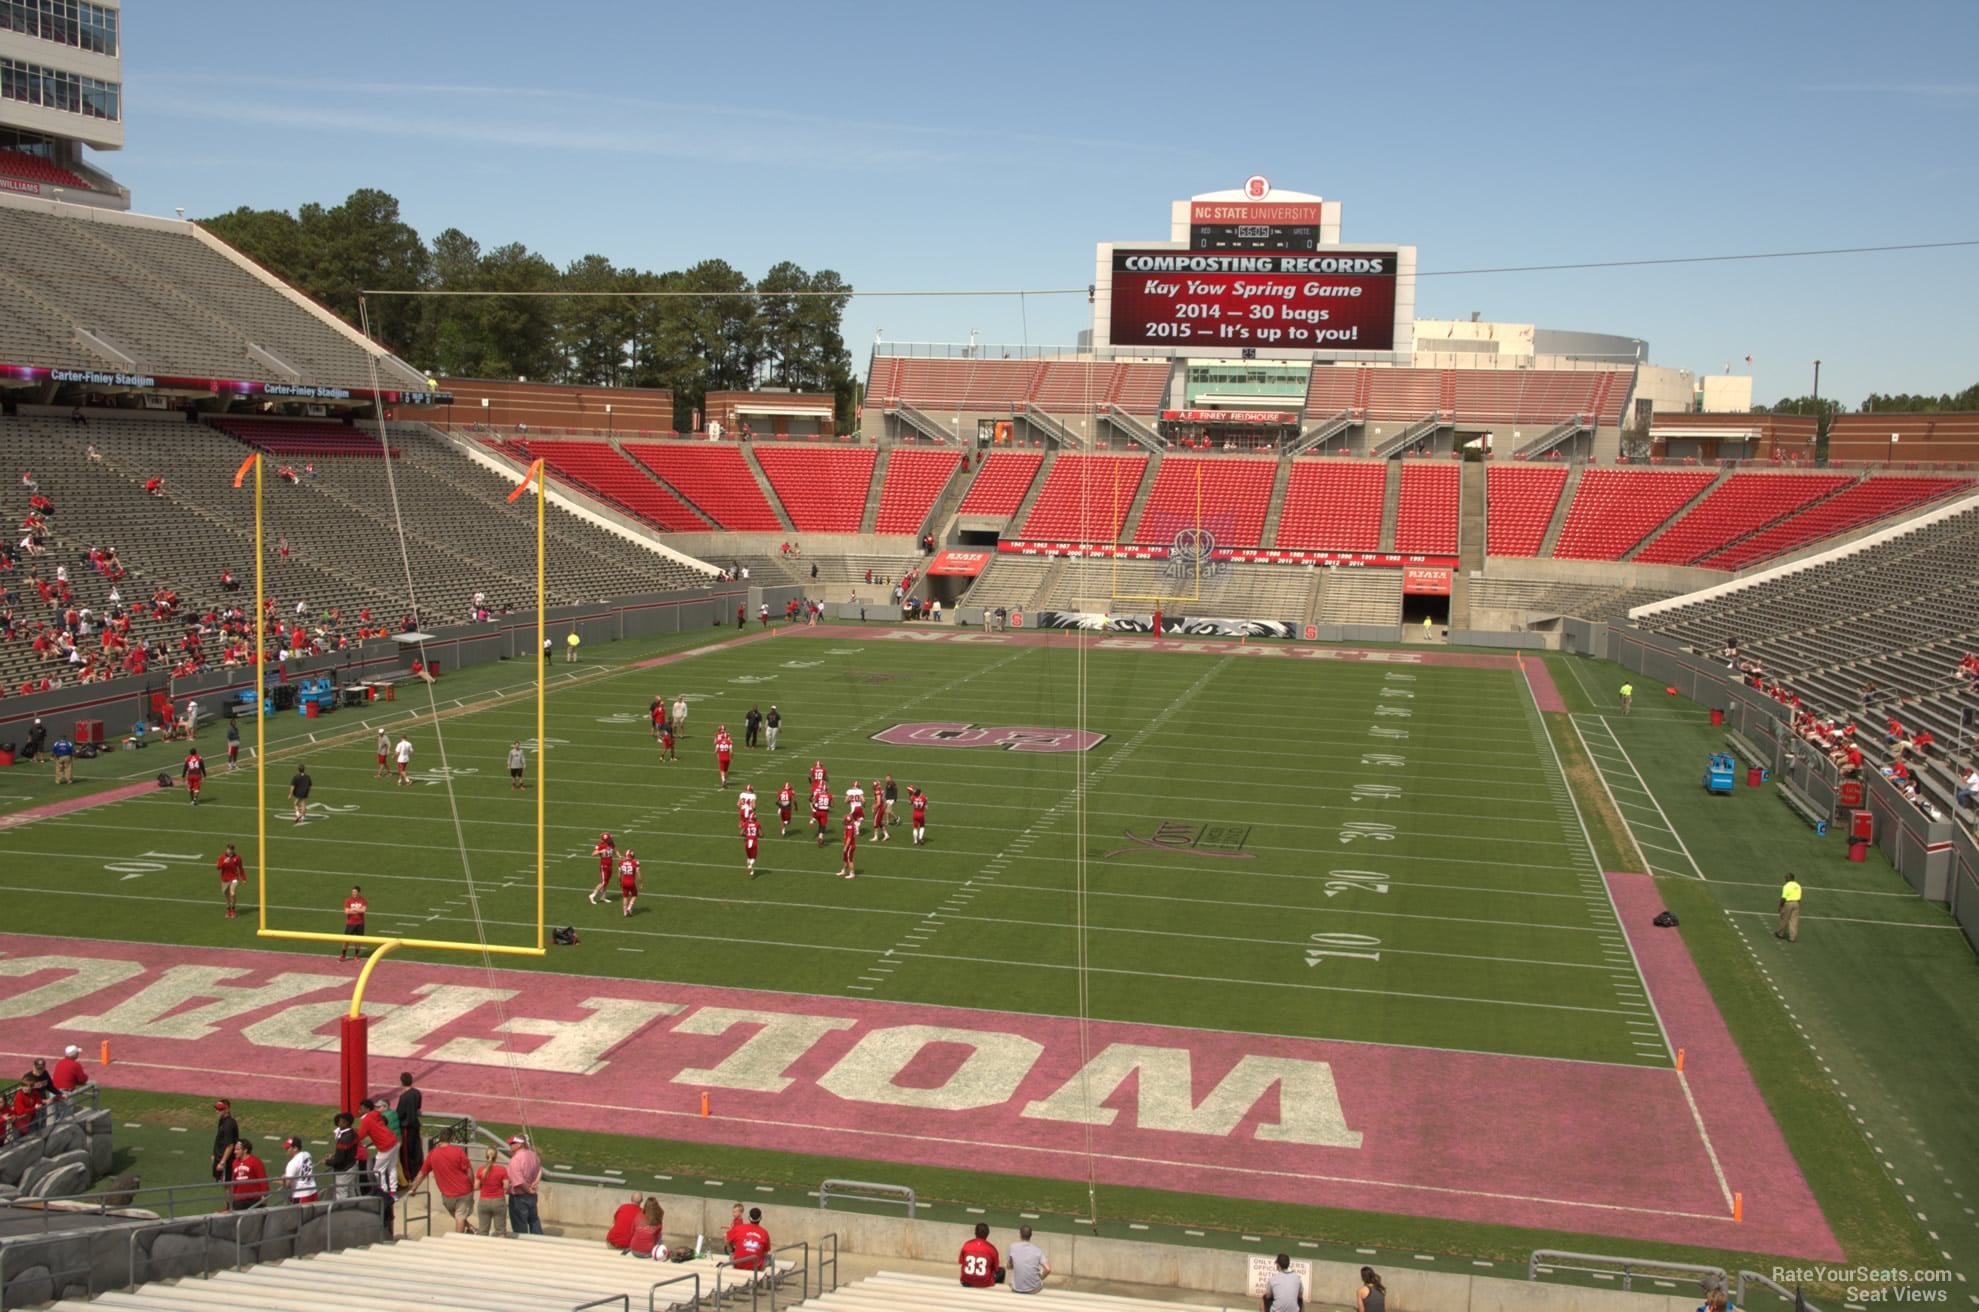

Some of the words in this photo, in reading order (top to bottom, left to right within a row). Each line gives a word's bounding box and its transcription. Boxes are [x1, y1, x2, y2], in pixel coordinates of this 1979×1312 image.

[1195, 207, 1211, 218] NC
[1214, 207, 1248, 219] STATE
[1251, 208, 1317, 219] UNIVERSITY
[1125, 256, 1273, 271] COMPOSTING
[1280, 258, 1383, 273] RECORDS
[1144, 280, 1180, 298] Kay
[1187, 280, 1227, 295] Yow
[1231, 281, 1297, 299] Spring
[1303, 282, 1362, 297] Game
[1175, 304, 1221, 318] 2014
[1249, 305, 1275, 319] 30
[1281, 305, 1330, 324] bags
[1145, 322, 1191, 337] 2015
[1257, 327, 1282, 342] up
[1288, 326, 1309, 339] to
[1315, 326, 1358, 343] you!
[51, 369, 113, 385] Carter-Finley
[115, 374, 155, 387] Stadium
[264, 384, 315, 398] Carter-Finley
[317, 387, 349, 399] Stadium
[1200, 412, 1226, 420] FINLEY
[1231, 413, 1279, 421] FIELDHOUSE
[1165, 562, 1226, 578] Allsate
[747, 827, 757, 836] 13
[1324, 870, 1390, 894] 20
[1305, 932, 1382, 961] 10
[964, 1255, 987, 1276] 33
